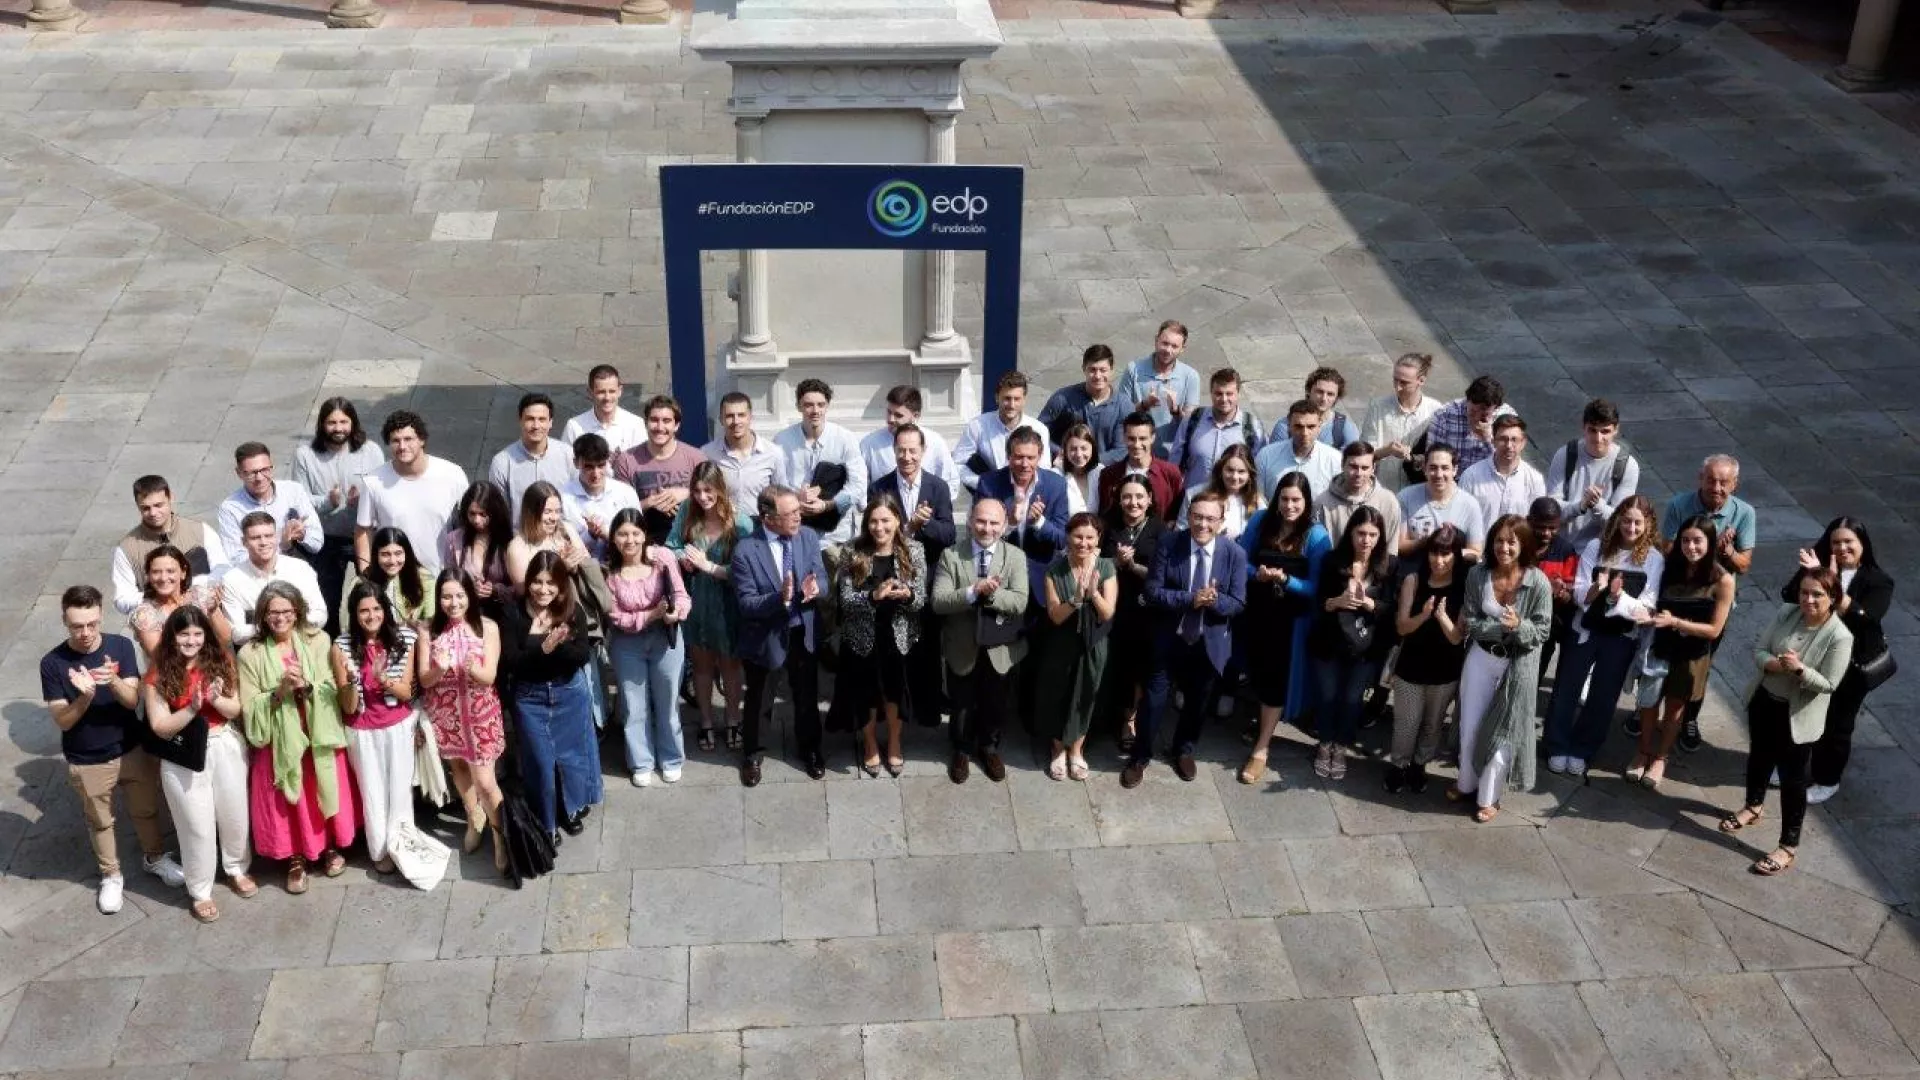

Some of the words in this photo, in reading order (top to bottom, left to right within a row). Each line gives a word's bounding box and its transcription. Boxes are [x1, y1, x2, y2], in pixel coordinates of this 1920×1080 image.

[698, 201, 814, 215] #FundaciónEDP
[932, 186, 988, 221] edp
[932, 222, 986, 233] Fundación
